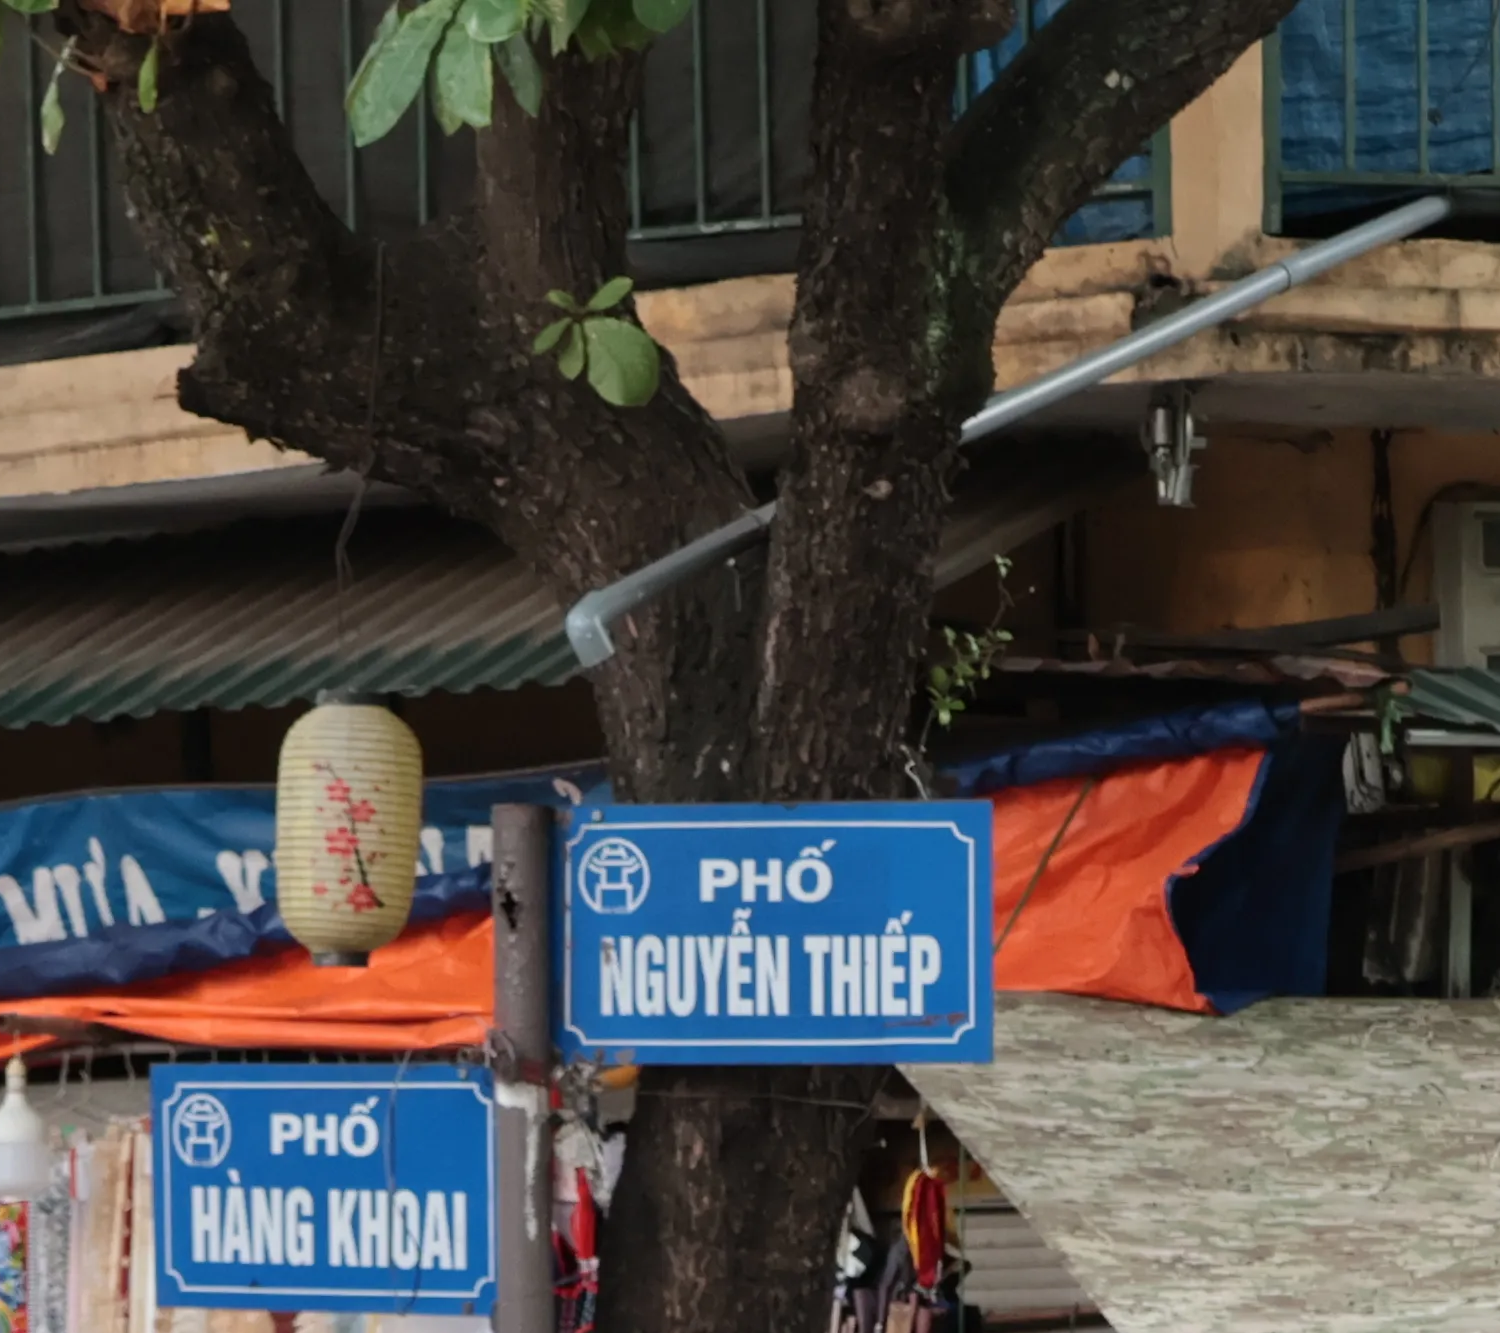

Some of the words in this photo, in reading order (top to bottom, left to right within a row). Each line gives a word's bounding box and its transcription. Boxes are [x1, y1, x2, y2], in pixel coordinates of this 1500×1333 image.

[700, 839, 836, 902] PHỐ
[601, 908, 790, 1017] NGUYỄN
[804, 911, 941, 1016] THIẾP
[270, 1096, 379, 1157] PHỐ
[191, 1169, 314, 1266] HÀNG
[328, 1189, 468, 1270] KHOAI
